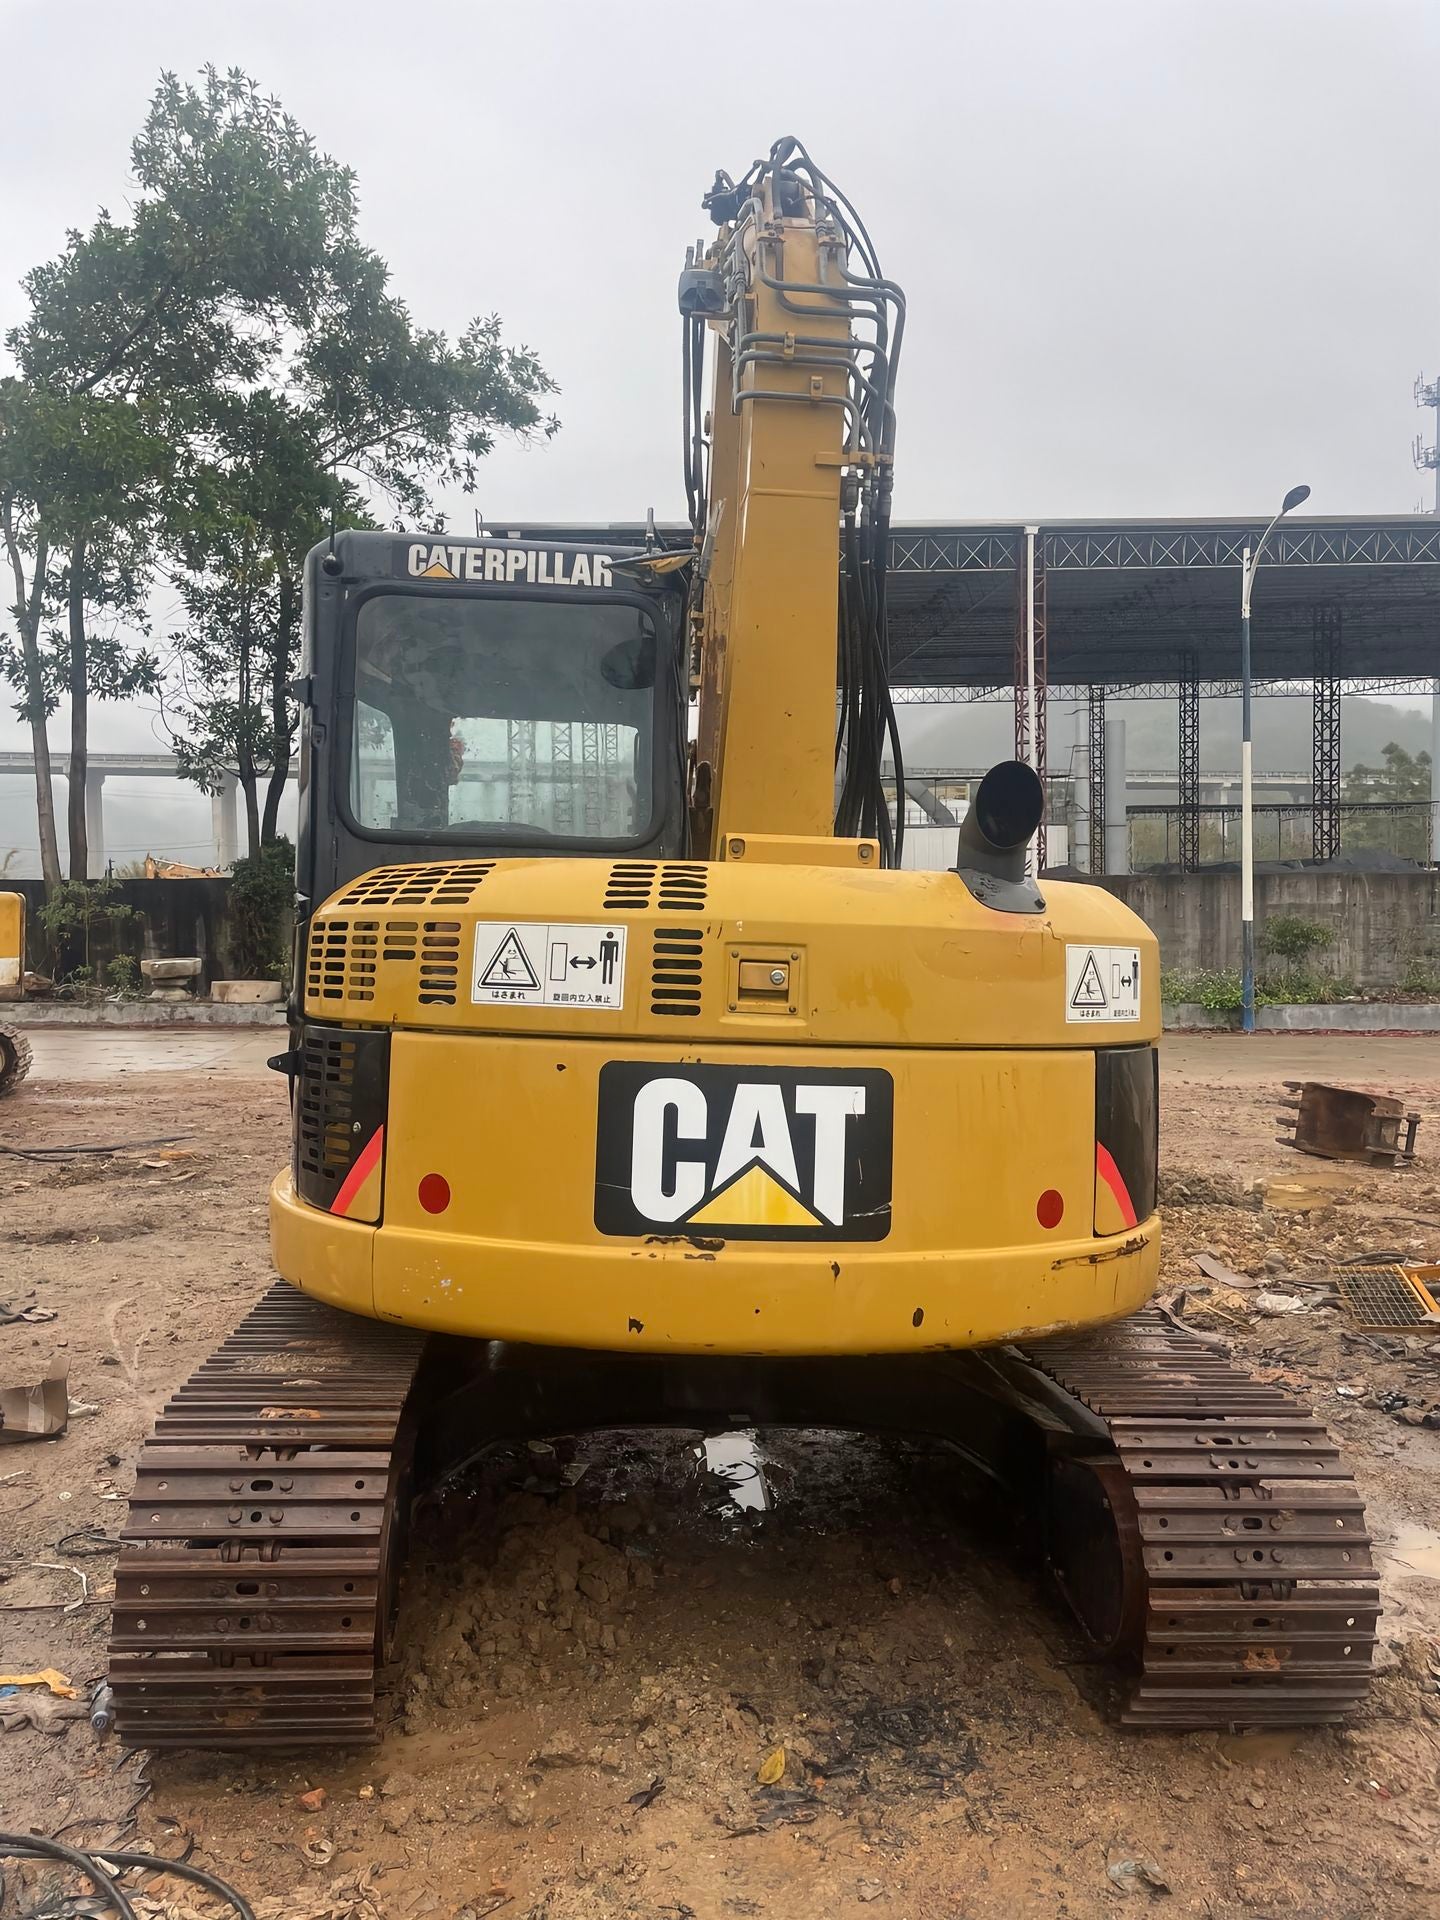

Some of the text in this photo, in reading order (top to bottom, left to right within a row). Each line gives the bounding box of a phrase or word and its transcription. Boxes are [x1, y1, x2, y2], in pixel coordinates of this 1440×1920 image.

[408, 544, 613, 587] CATERPILLAR
[492, 991, 525, 999] はさまれ
[631, 1078, 866, 1226] CAT
